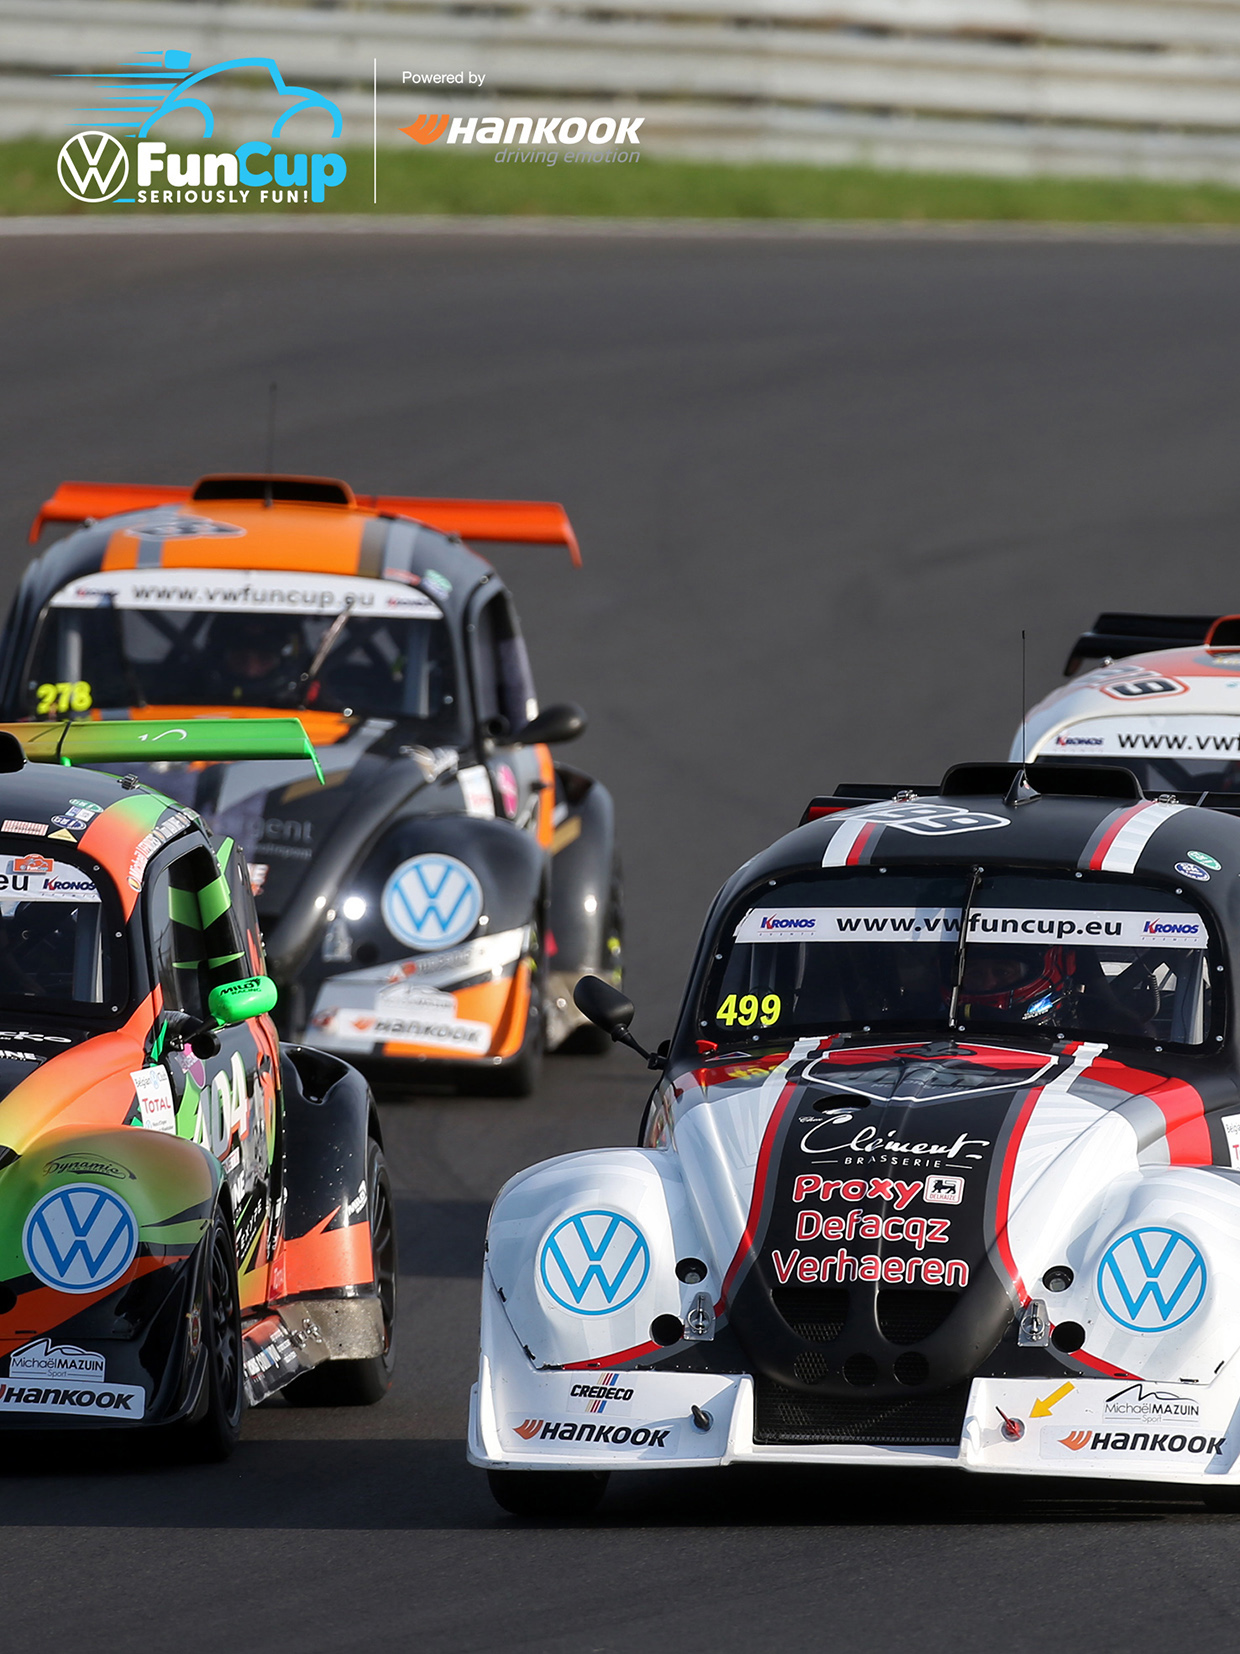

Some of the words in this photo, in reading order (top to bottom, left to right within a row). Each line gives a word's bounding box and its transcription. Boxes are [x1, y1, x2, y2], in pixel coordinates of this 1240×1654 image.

[37, 680, 93, 713] 278
[761, 913, 816, 930] KRONOS
[836, 913, 1123, 939] www.vwfuncup.eu
[1143, 917, 1200, 934] KRONOS
[716, 994, 782, 1027] 499
[844, 1154, 943, 1169] BRASSERIE
[792, 1173, 924, 1211] Proxy
[26, 1186, 134, 1290] VW
[795, 1209, 951, 1250] Defacqz
[540, 1210, 651, 1316] VW
[771, 1248, 970, 1288] Verhaeren
[1097, 1226, 1207, 1333] VW
[570, 1384, 634, 1402] CREDECO
[1142, 1414, 1162, 1423] Sport
